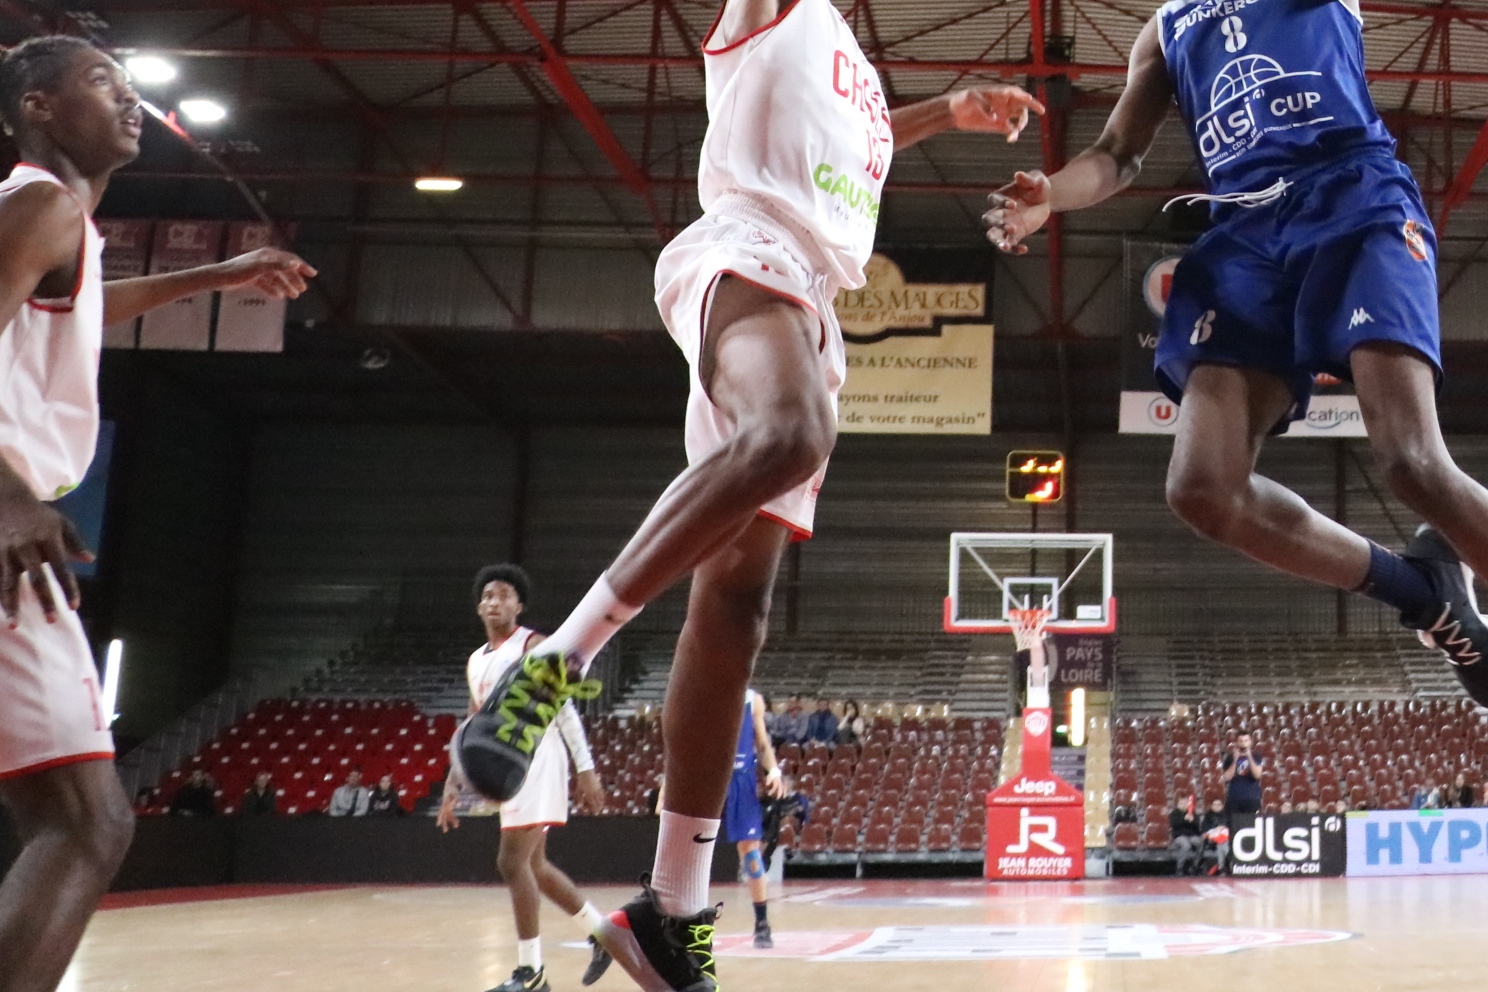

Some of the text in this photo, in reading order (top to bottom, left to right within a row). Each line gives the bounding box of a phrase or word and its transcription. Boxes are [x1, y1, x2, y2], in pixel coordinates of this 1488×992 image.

[1221, 16, 1247, 53] 8
[1199, 96, 1255, 158] dlsi
[1270, 92, 1321, 117] CUP
[844, 287, 979, 310] DES MAUGES
[880, 357, 978, 370] L'ANCIENNE
[884, 391, 940, 403] traiteur
[846, 412, 864, 423] de
[869, 414, 906, 423] votre
[1066, 646, 1103, 662] PAYS
[1061, 669, 1102, 683] LOIRE
[1013, 776, 1057, 796] Jeep
[1232, 815, 1321, 862] dlsi
[998, 856, 1073, 869] JEAN ROUYER
[1002, 868, 1069, 876] AUTOMOBILES
